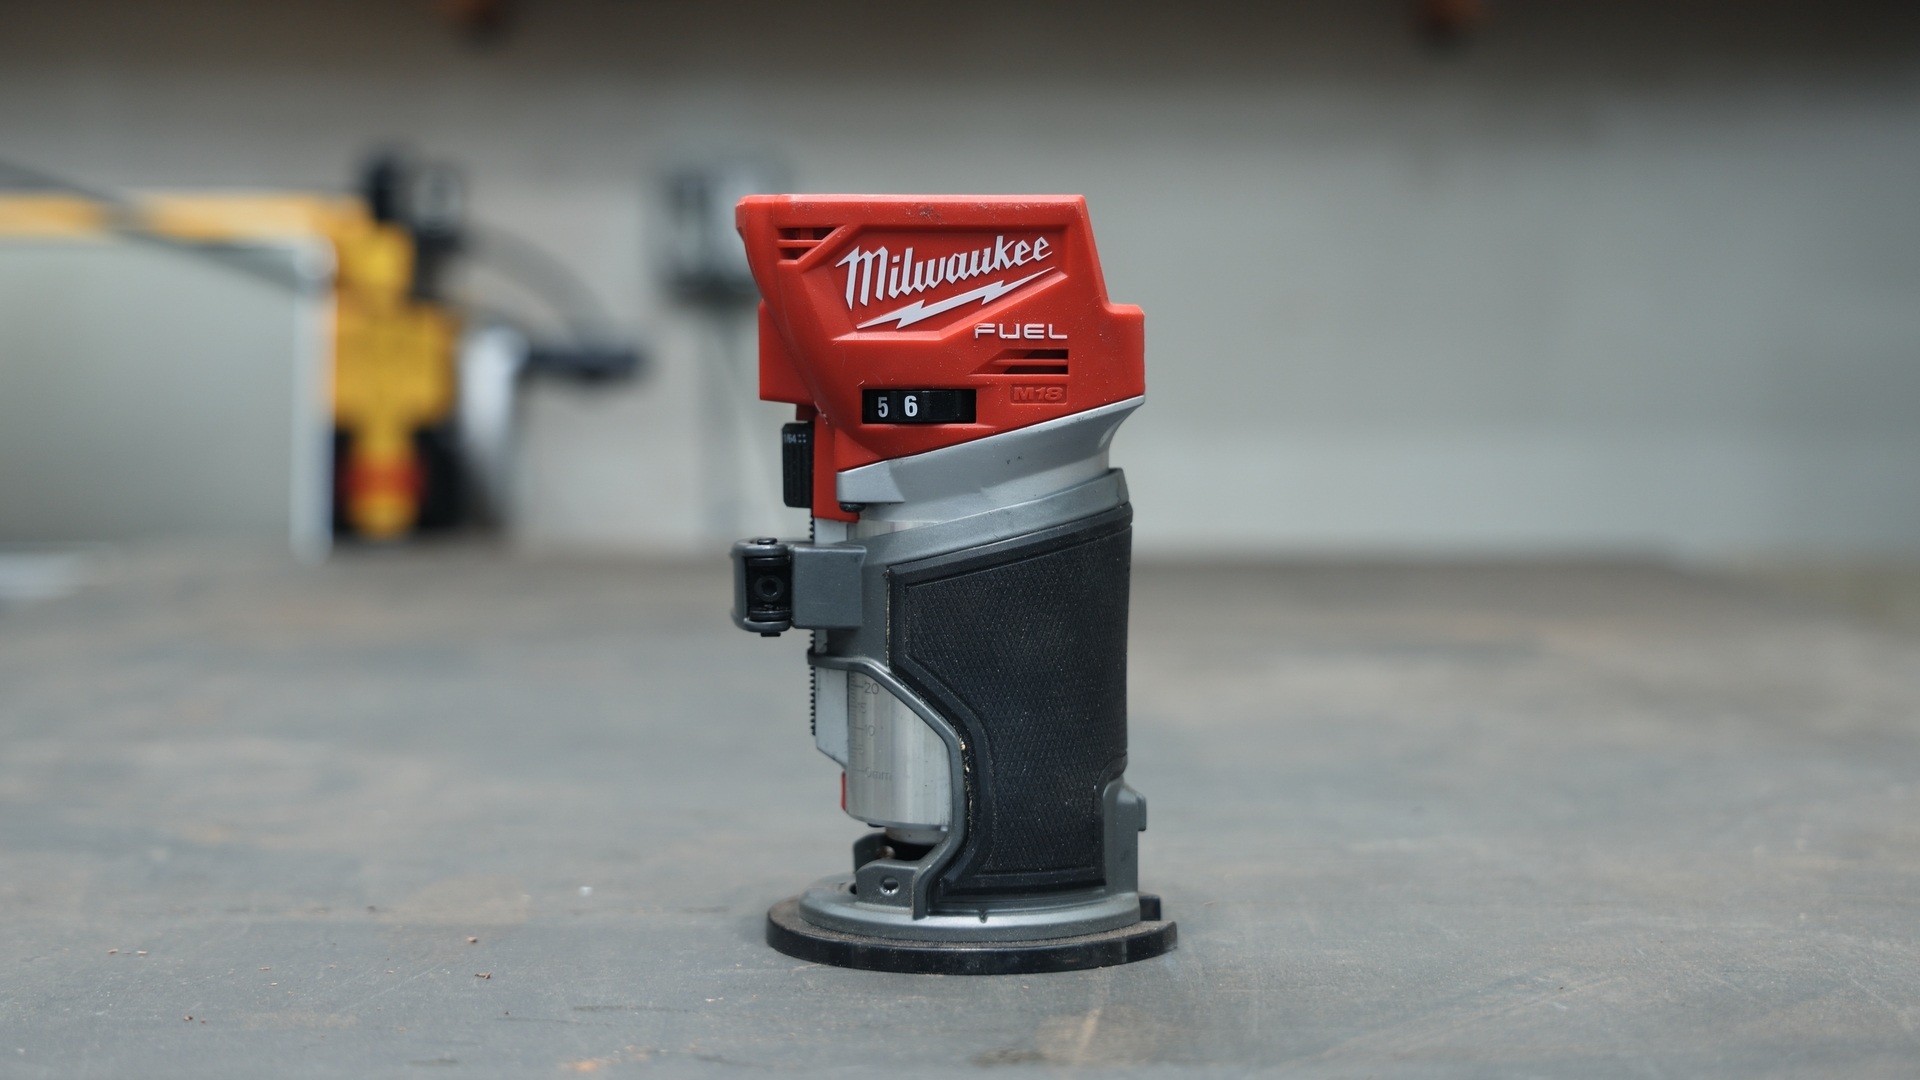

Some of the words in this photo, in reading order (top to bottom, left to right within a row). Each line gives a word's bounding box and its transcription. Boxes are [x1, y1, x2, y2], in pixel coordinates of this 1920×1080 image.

[835, 235, 1053, 312] Milwaukee
[974, 323, 1068, 339] FUEL
[1013, 386, 1063, 401] M18
[877, 397, 889, 418] 5
[904, 395, 918, 417] 6
[864, 681, 880, 695] 20
[864, 724, 876, 737] 10
